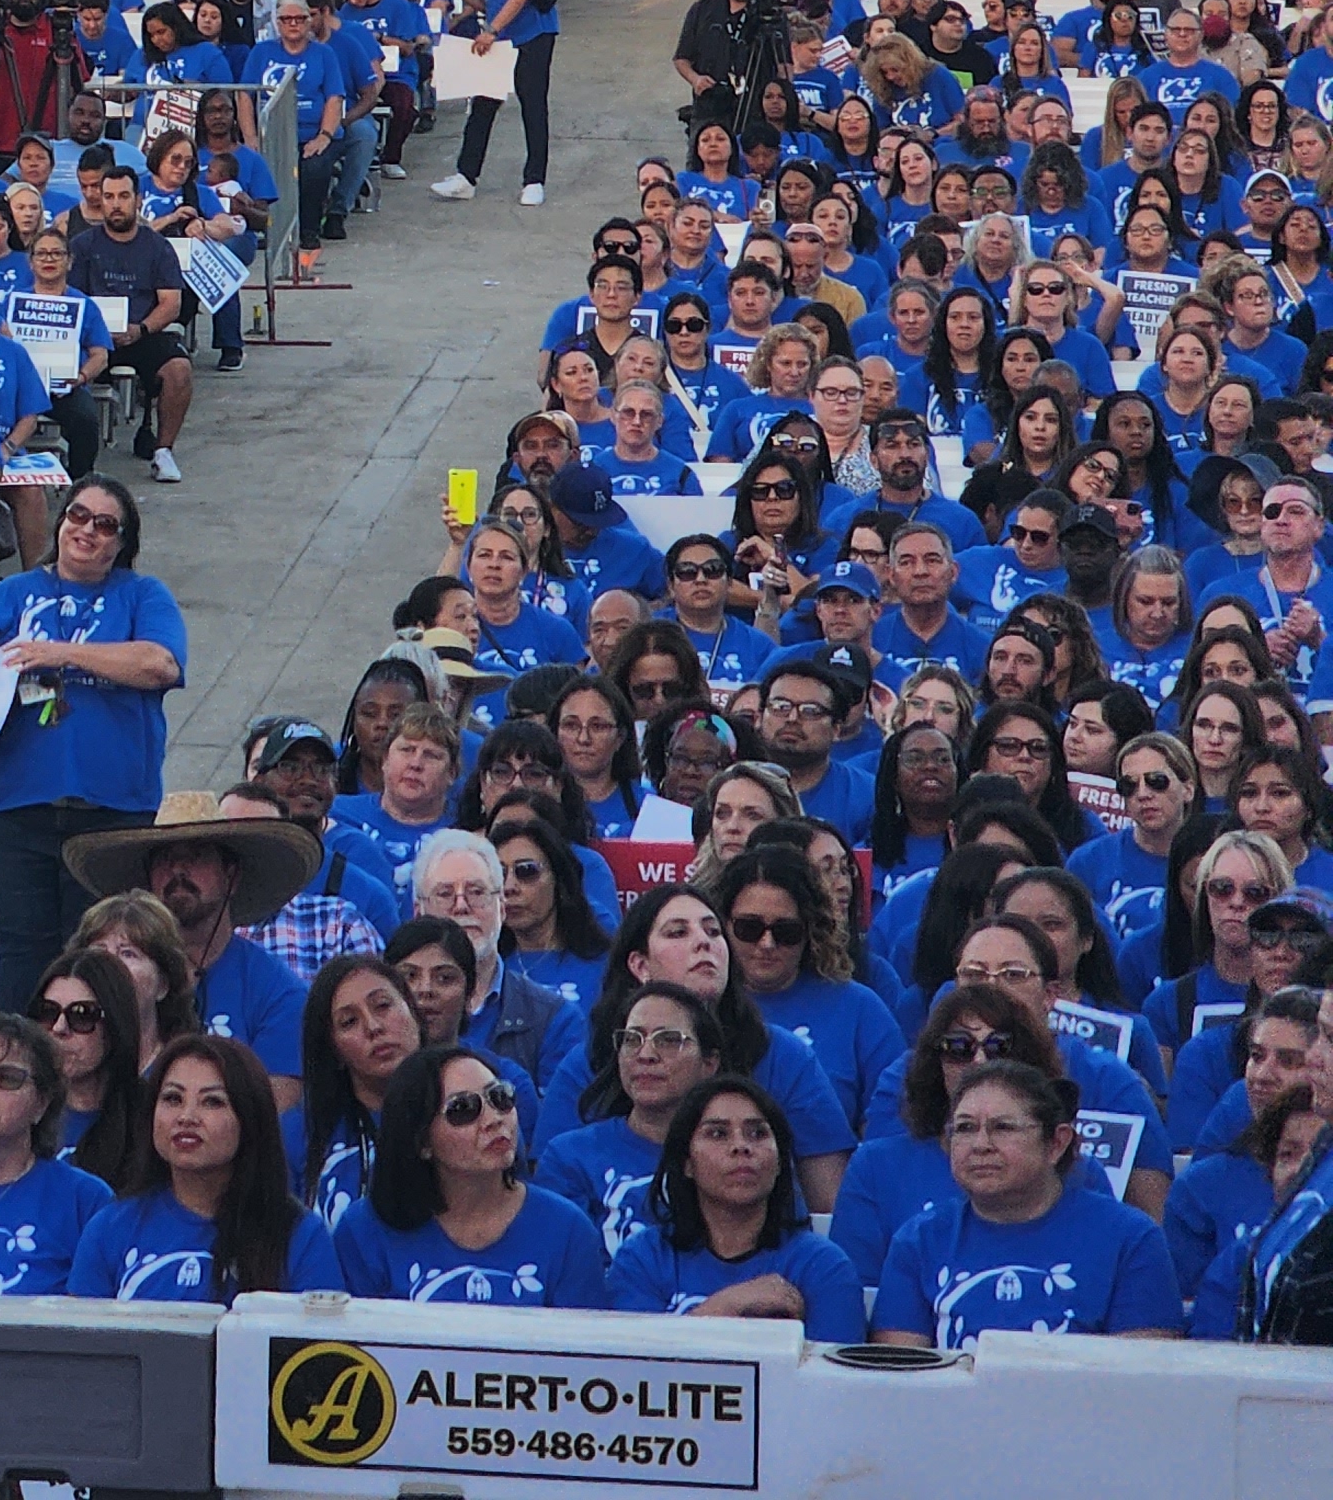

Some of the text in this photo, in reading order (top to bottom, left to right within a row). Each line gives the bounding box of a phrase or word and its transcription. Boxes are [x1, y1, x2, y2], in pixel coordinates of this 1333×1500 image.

[1133, 279, 1180, 295] FRESNO
[24, 299, 68, 314] FRESNO
[1126, 292, 1176, 306] TEACHER
[17, 310, 73, 325] TEACHERS
[15, 326, 69, 341] READY TO
[835, 562, 851, 577] B
[638, 861, 676, 883] WE
